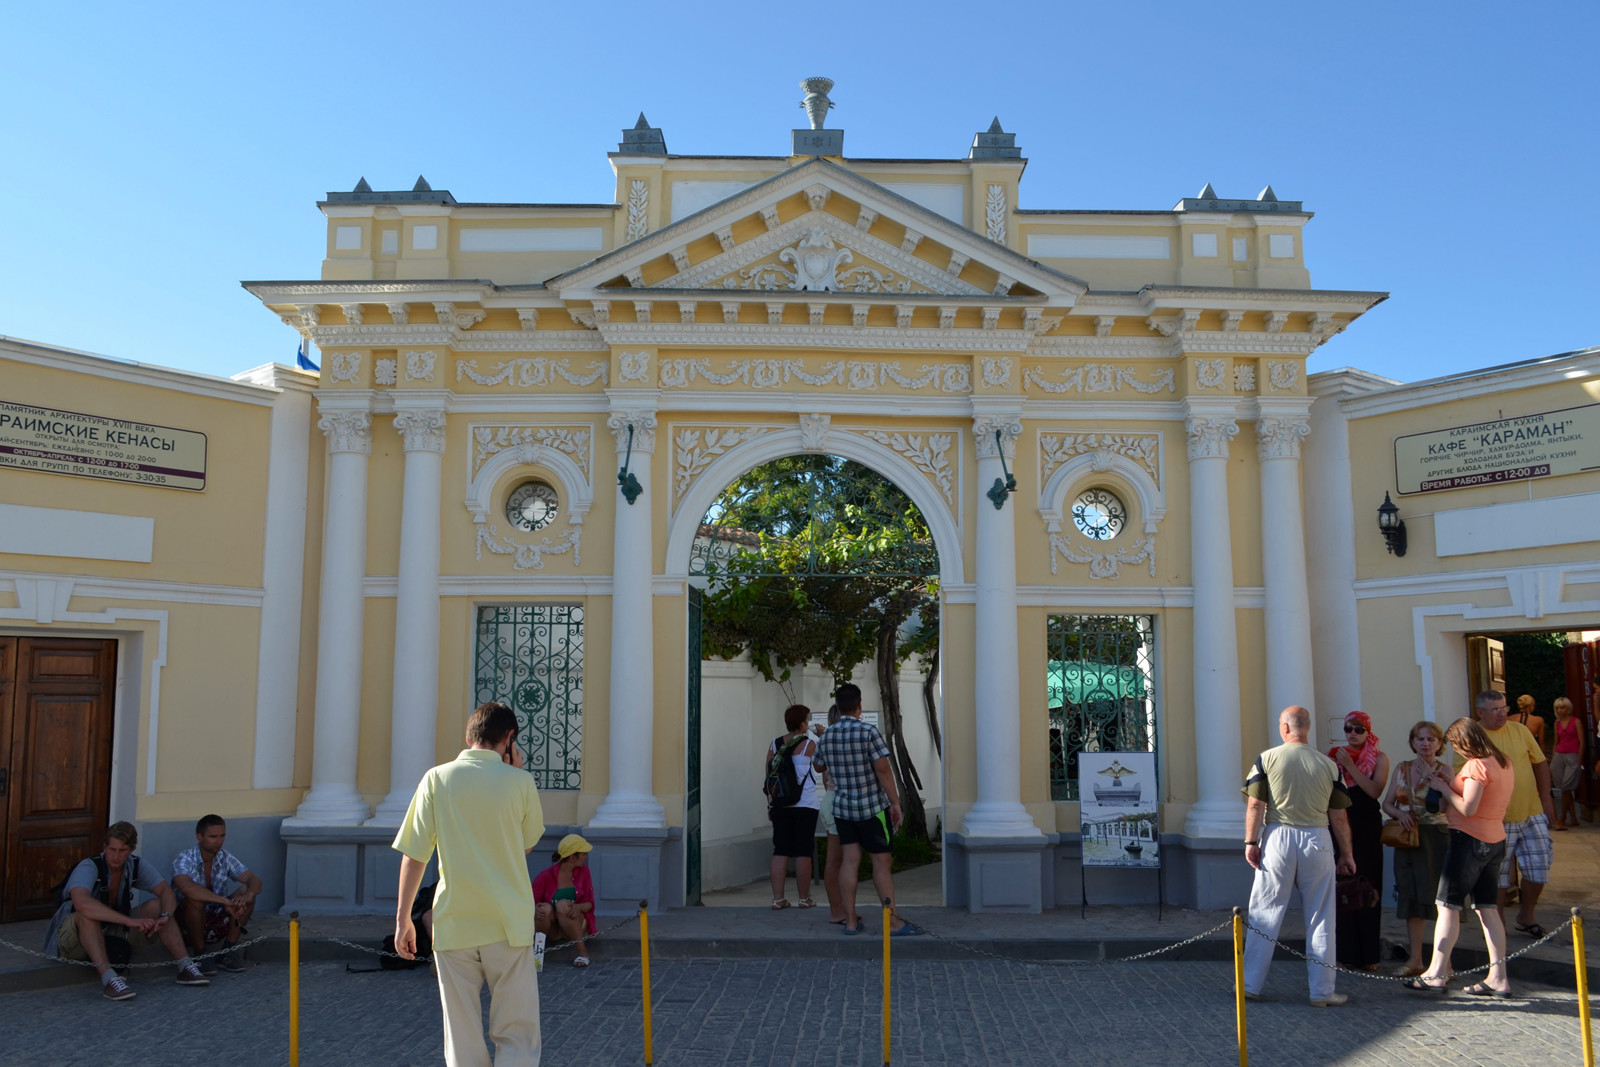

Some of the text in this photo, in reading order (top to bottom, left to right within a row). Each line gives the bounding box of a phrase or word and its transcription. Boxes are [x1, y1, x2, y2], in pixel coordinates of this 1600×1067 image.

[0, 414, 176, 452] РАИМСКИЕ КЕНАСЫ
[50, 411, 109, 426] АРХИТЕКТУРЫ
[112, 418, 132, 430] XVIII
[135, 424, 156, 434] ВЕКА
[1449, 415, 1545, 437] КАРАИМСКАЯ КУХНЯ
[35, 433, 69, 443] ОТКРЫТЫ
[87, 440, 120, 450] ОСМОТРА:
[1428, 439, 1467, 455] КАФЕ
[13, 448, 76, 462] ОКТЯБРЬ-АПРЕЛЬ:
[86, 457, 106, 466] 12-00
[120, 461, 140, 470] 17-00
[52, 443, 95, 455] ЕЖЕДНЕВНО
[137, 455, 157, 464] 20-00
[1420, 453, 1451, 464] ГОРЯЧИЕ
[1427, 450, 1577, 478] ДРУГИЕ БЛЮДА НАЦИОНАЛЬНОЙ КУХНИ
[1463, 453, 1503, 465] ХОЛОДНАЯ
[20, 459, 38, 467] ДЛЯ
[41, 461, 70, 471] ГРУПП
[73, 465, 85, 473] ПО
[88, 467, 133, 479] ТЕЛЕФОНУ:
[135, 472, 167, 484] 3-30-35
[1422, 466, 1548, 490] ВРЕМЯ РАБОТЫ: С 12-00 ДО
